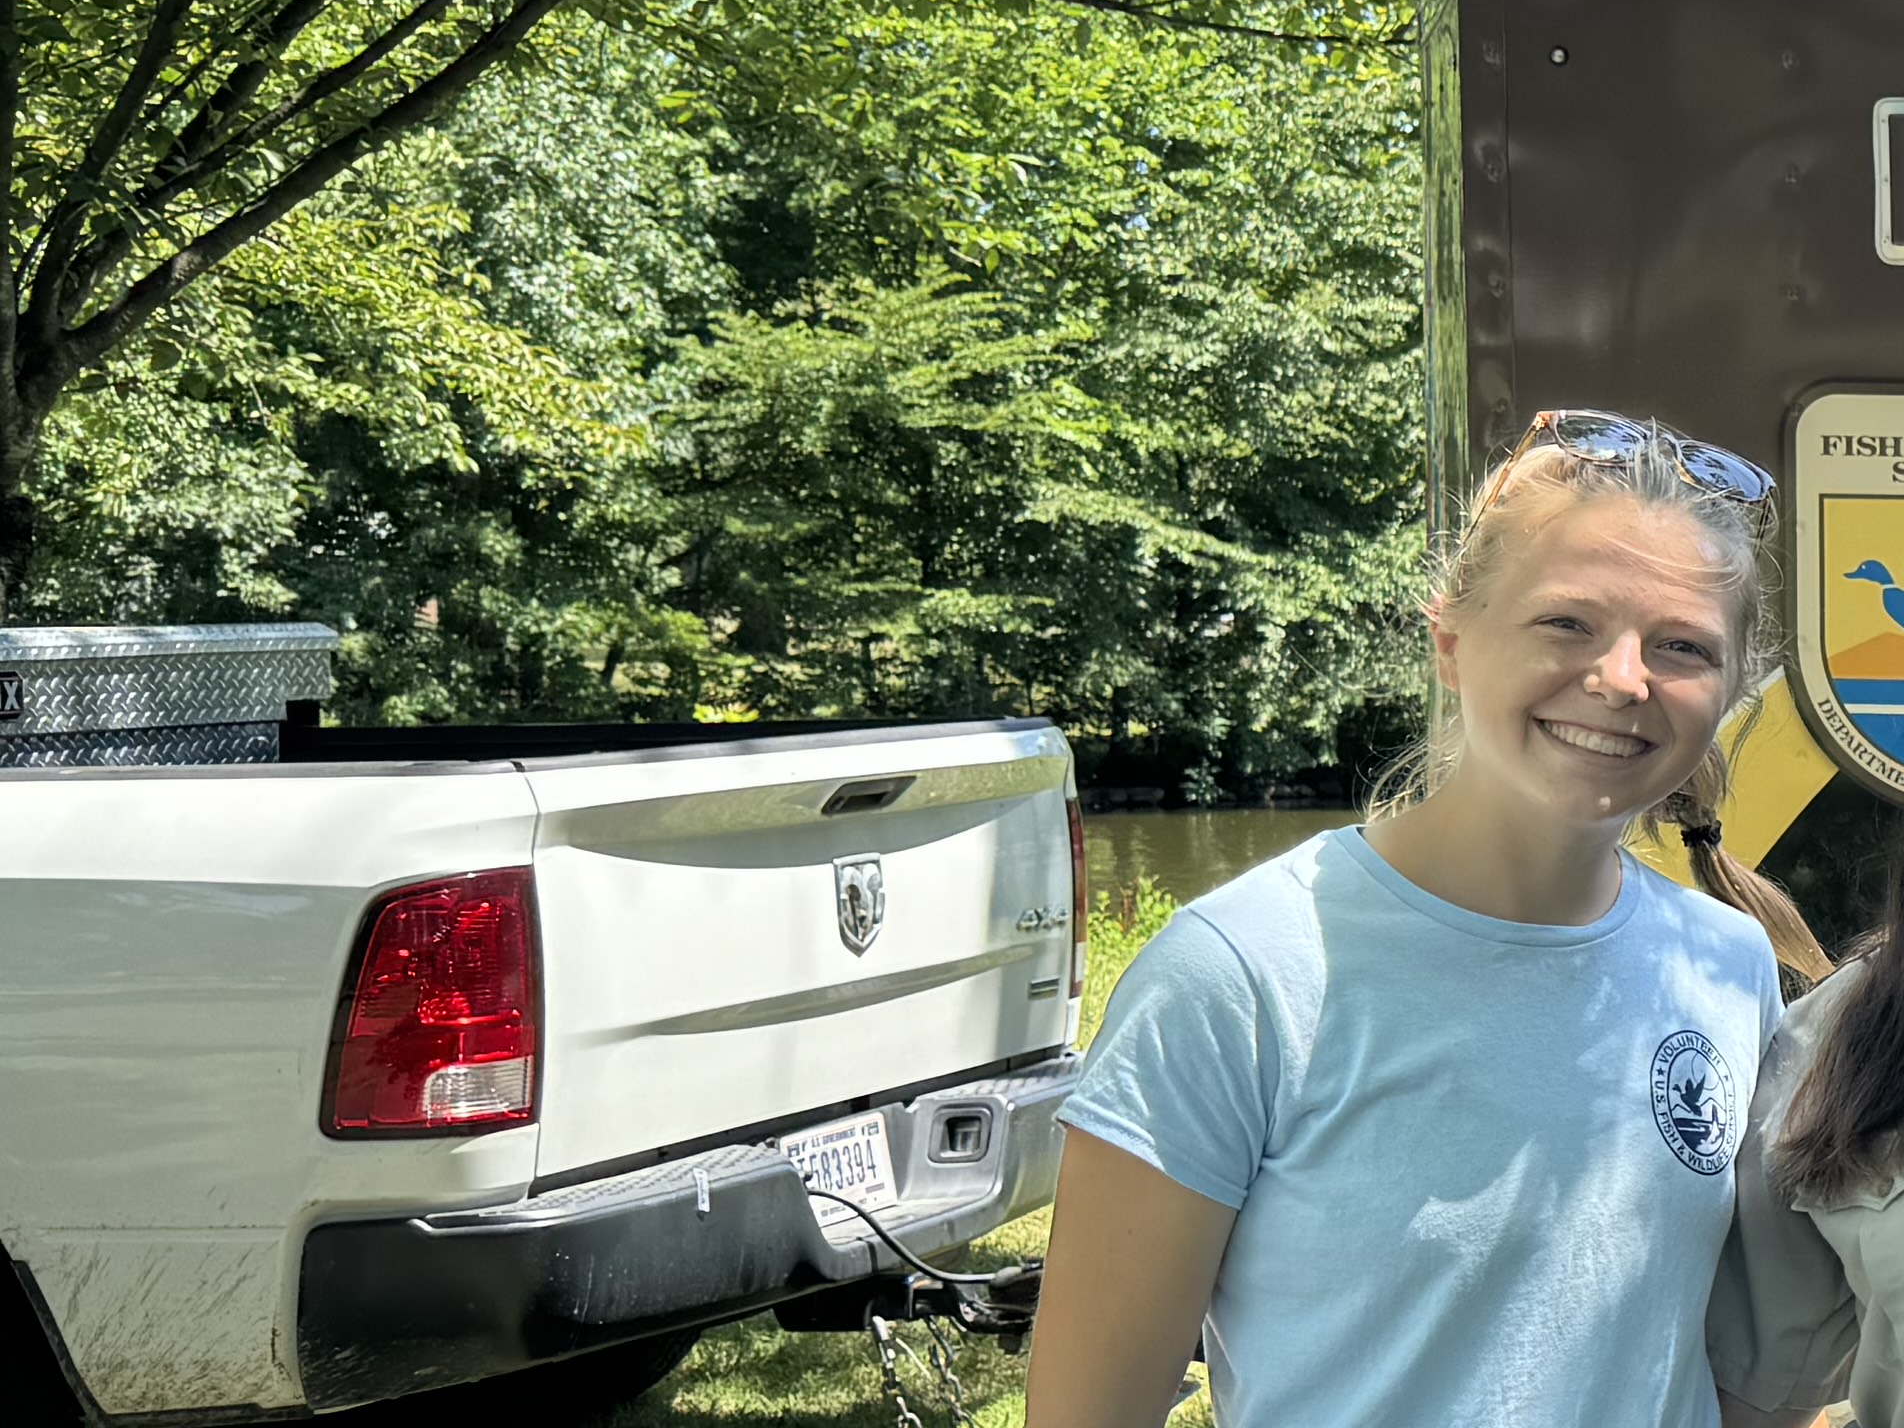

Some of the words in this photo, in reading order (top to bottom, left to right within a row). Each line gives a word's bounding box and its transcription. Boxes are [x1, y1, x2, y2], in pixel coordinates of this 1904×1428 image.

[1819, 435, 1904, 458] FISH
[1654, 1080, 1666, 1109] U.S.
[1658, 1111, 1679, 1143] FISH
